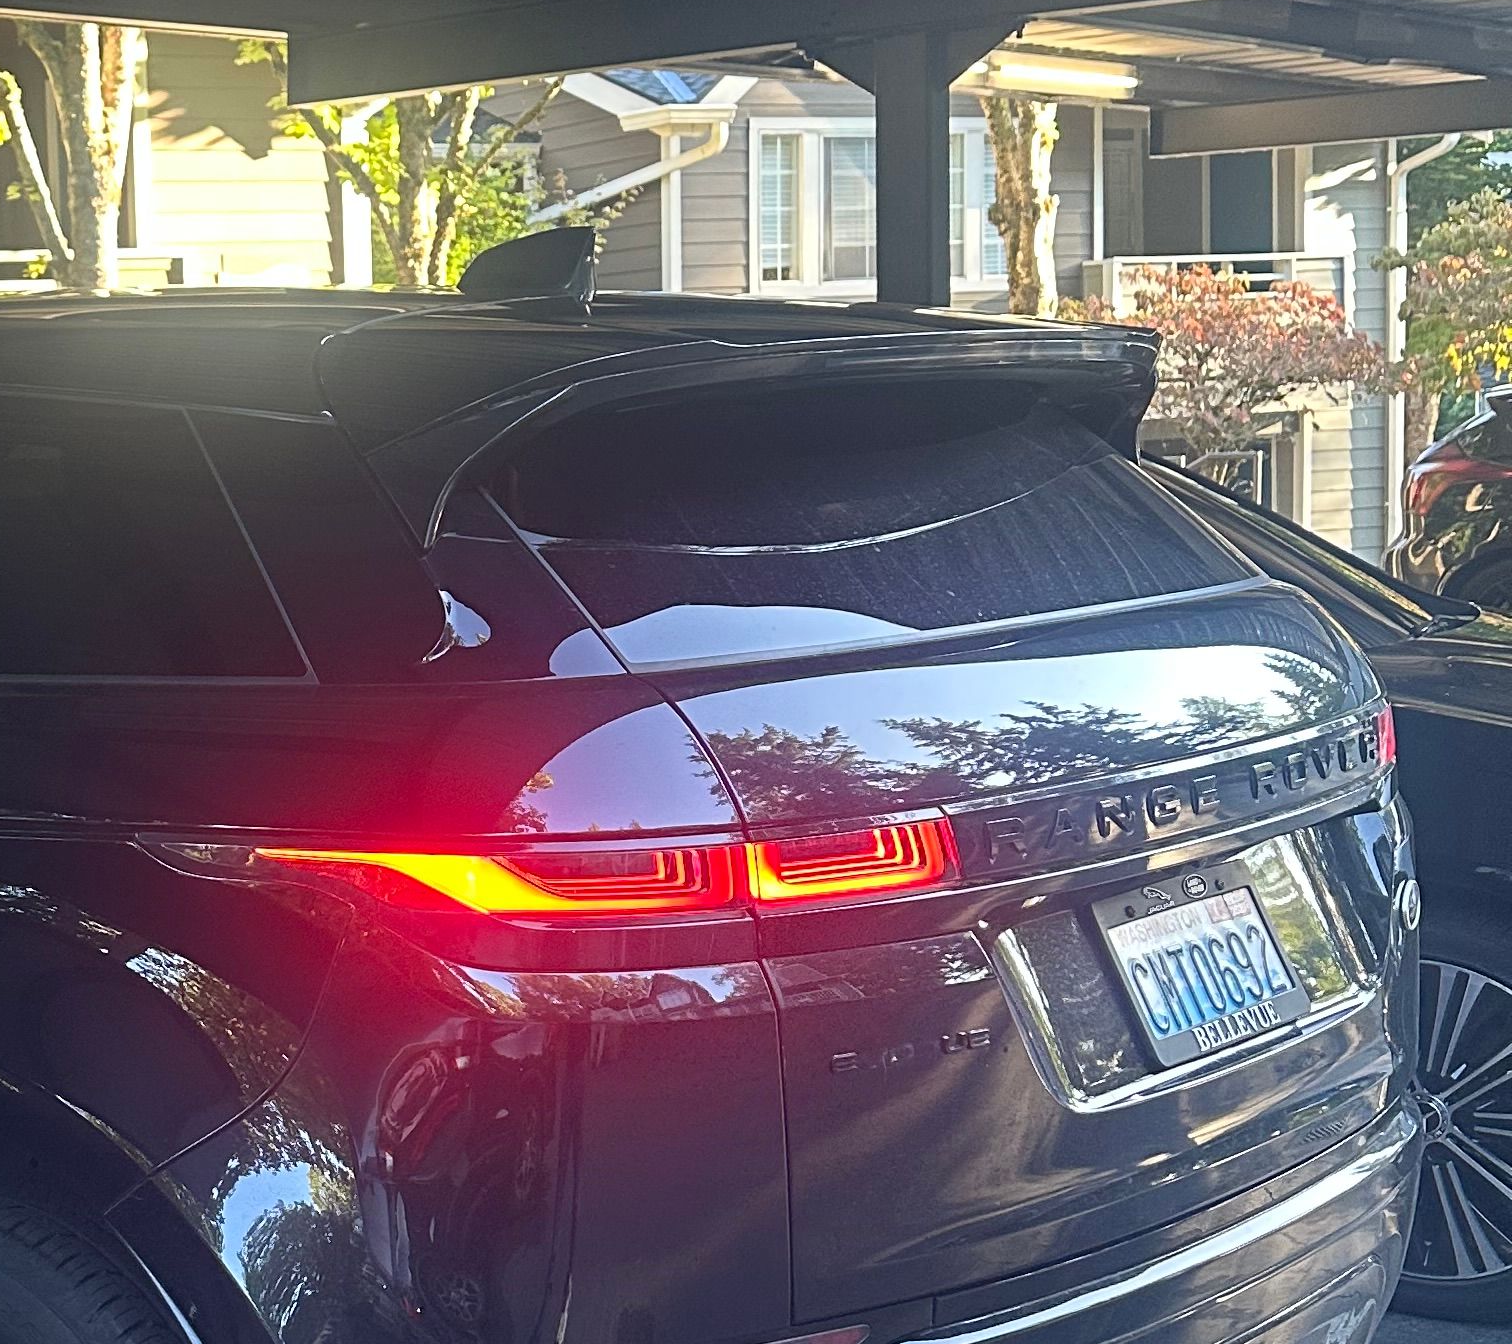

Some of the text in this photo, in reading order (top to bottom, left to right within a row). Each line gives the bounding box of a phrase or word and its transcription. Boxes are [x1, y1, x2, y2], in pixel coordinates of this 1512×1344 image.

[985, 773, 1220, 865] RANGE
[1115, 906, 1203, 948] WASHINGTON
[1130, 923, 1288, 1035] CMT0692
[1191, 1000, 1282, 1053] BELLEVUE
